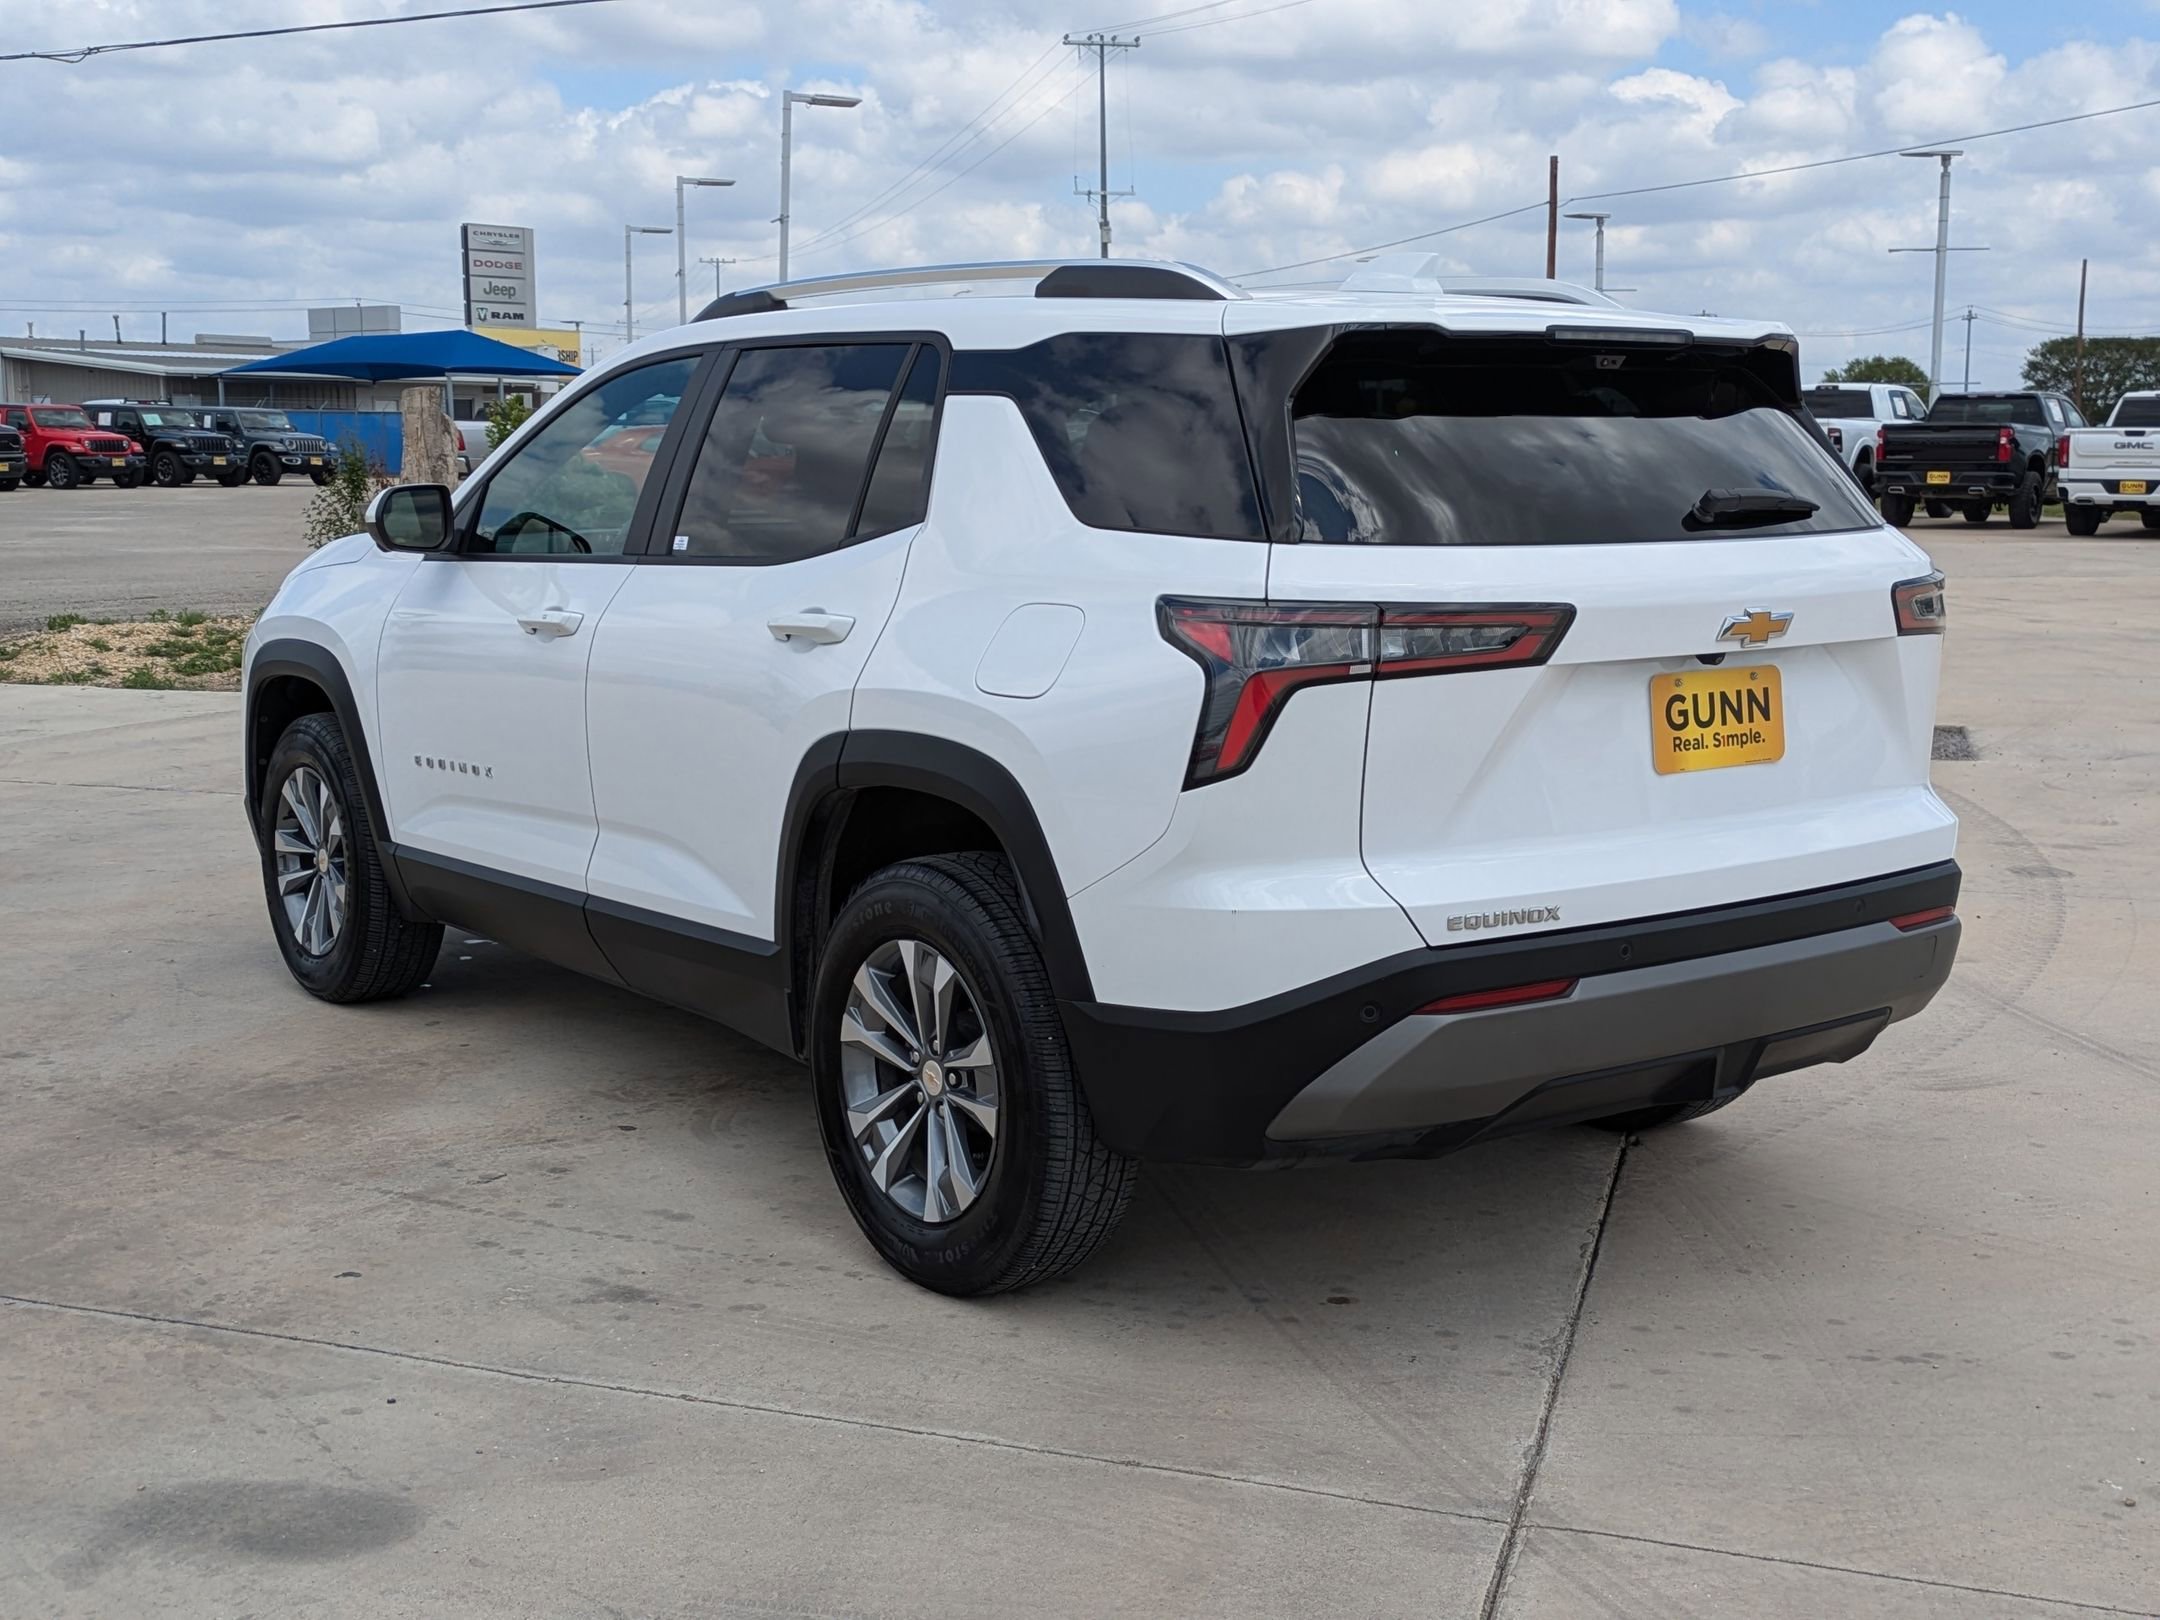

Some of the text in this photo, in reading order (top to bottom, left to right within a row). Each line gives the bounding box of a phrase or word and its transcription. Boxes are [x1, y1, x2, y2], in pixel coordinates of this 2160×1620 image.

[472, 230, 520, 239] CHRYSLER
[473, 259, 523, 270] DODGE
[483, 281, 516, 299] Jeep
[491, 311, 525, 320] RAM
[2114, 441, 2154, 450] GMC
[1665, 686, 1771, 732] GUNN
[1672, 733, 1709, 753] Real.
[414, 755, 494, 778] EQUINOX
[1446, 904, 1561, 931] EQUINOX
